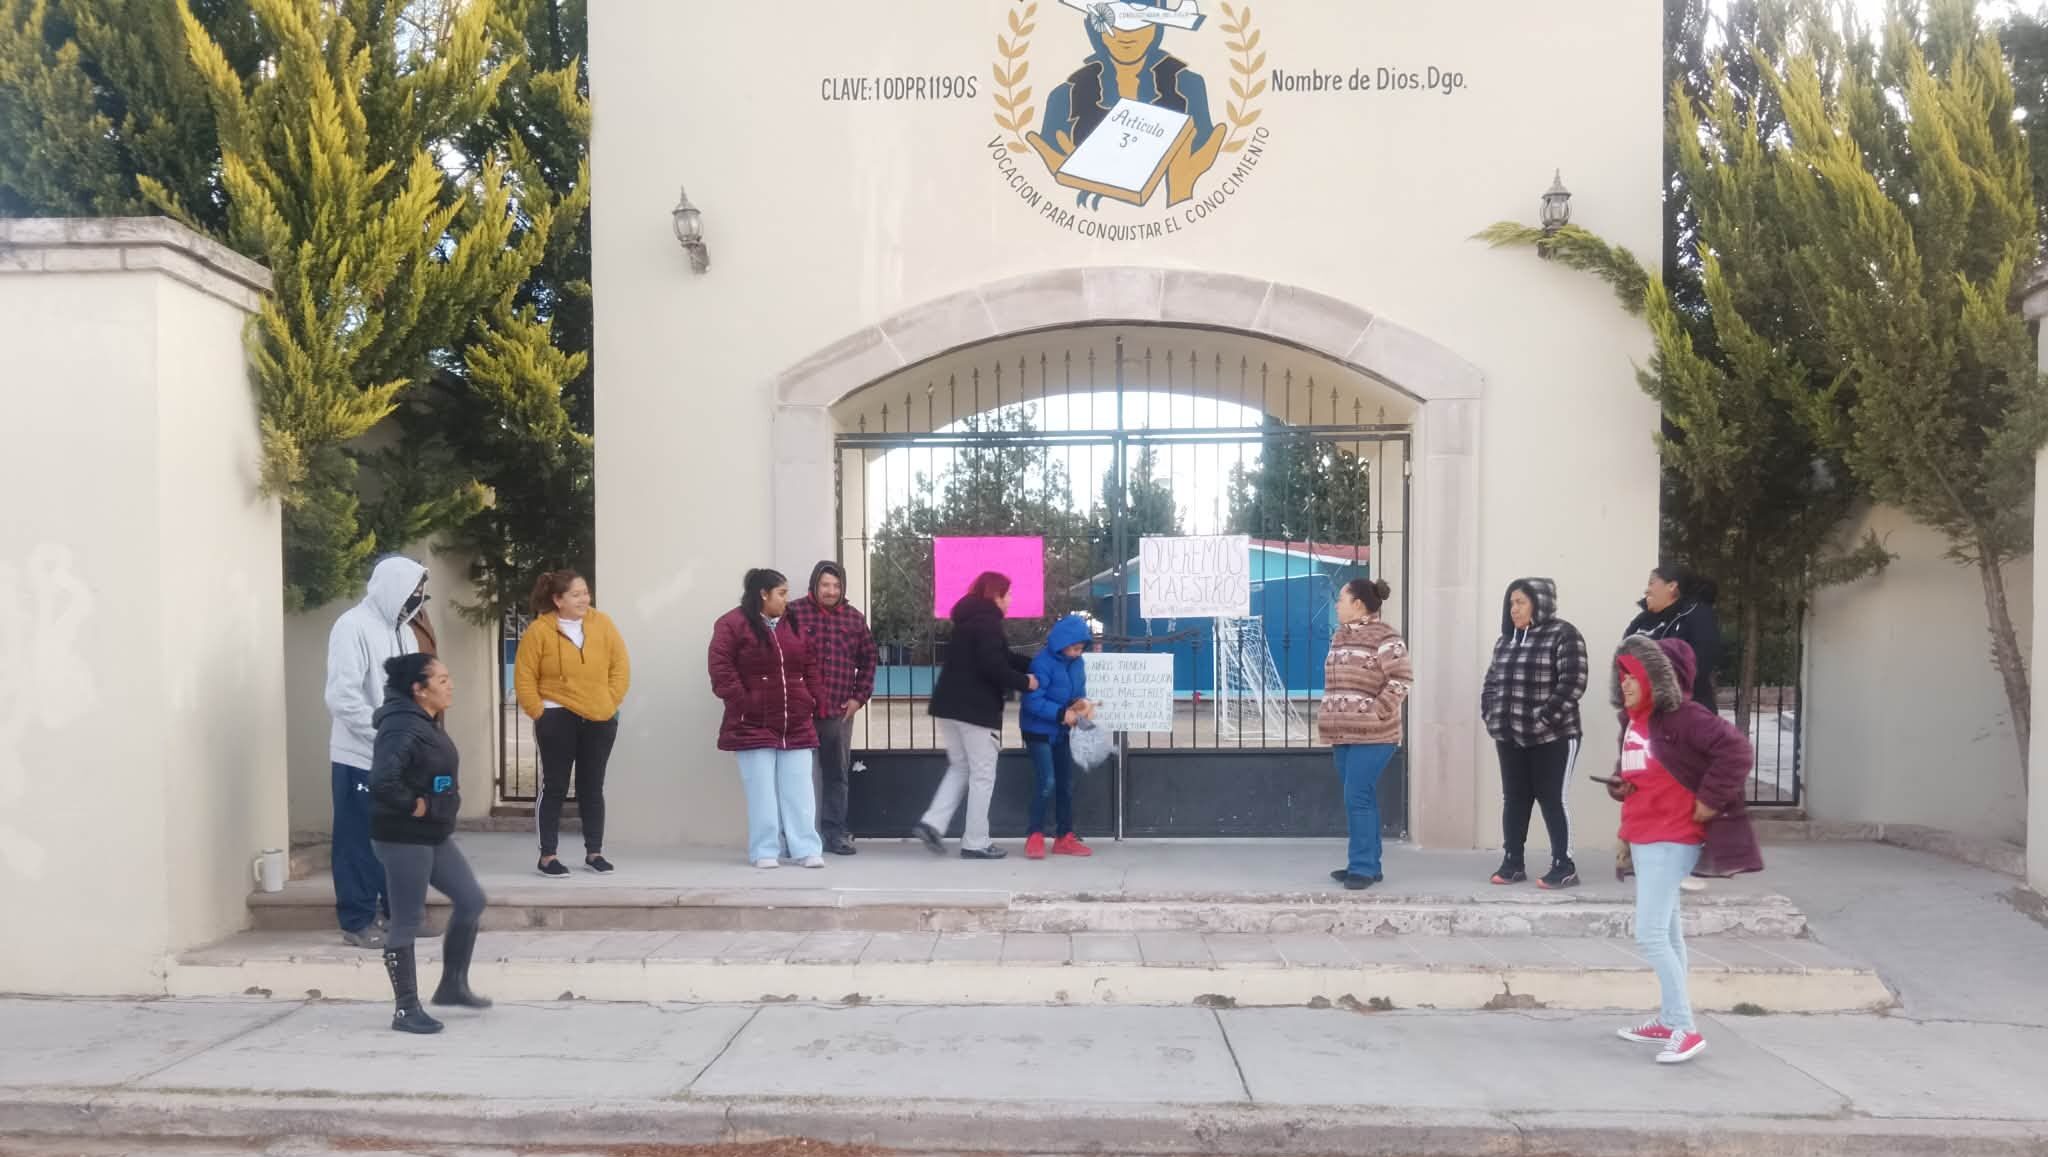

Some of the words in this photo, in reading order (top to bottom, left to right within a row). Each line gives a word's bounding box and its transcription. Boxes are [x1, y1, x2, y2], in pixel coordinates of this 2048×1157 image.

[1271, 69, 1343, 93] Nombre
[1348, 68, 1371, 91] de
[987, 135, 1042, 208] VOCACION
[1039, 202, 1074, 232] PARA
[1077, 219, 1163, 242] CONQUISTAR
[1165, 215, 1183, 235] EL
[1184, 126, 1271, 224] CONOCIMIENTO
[1143, 538, 1245, 576] QUEREMOS
[1143, 574, 1248, 607] MAESTROS
